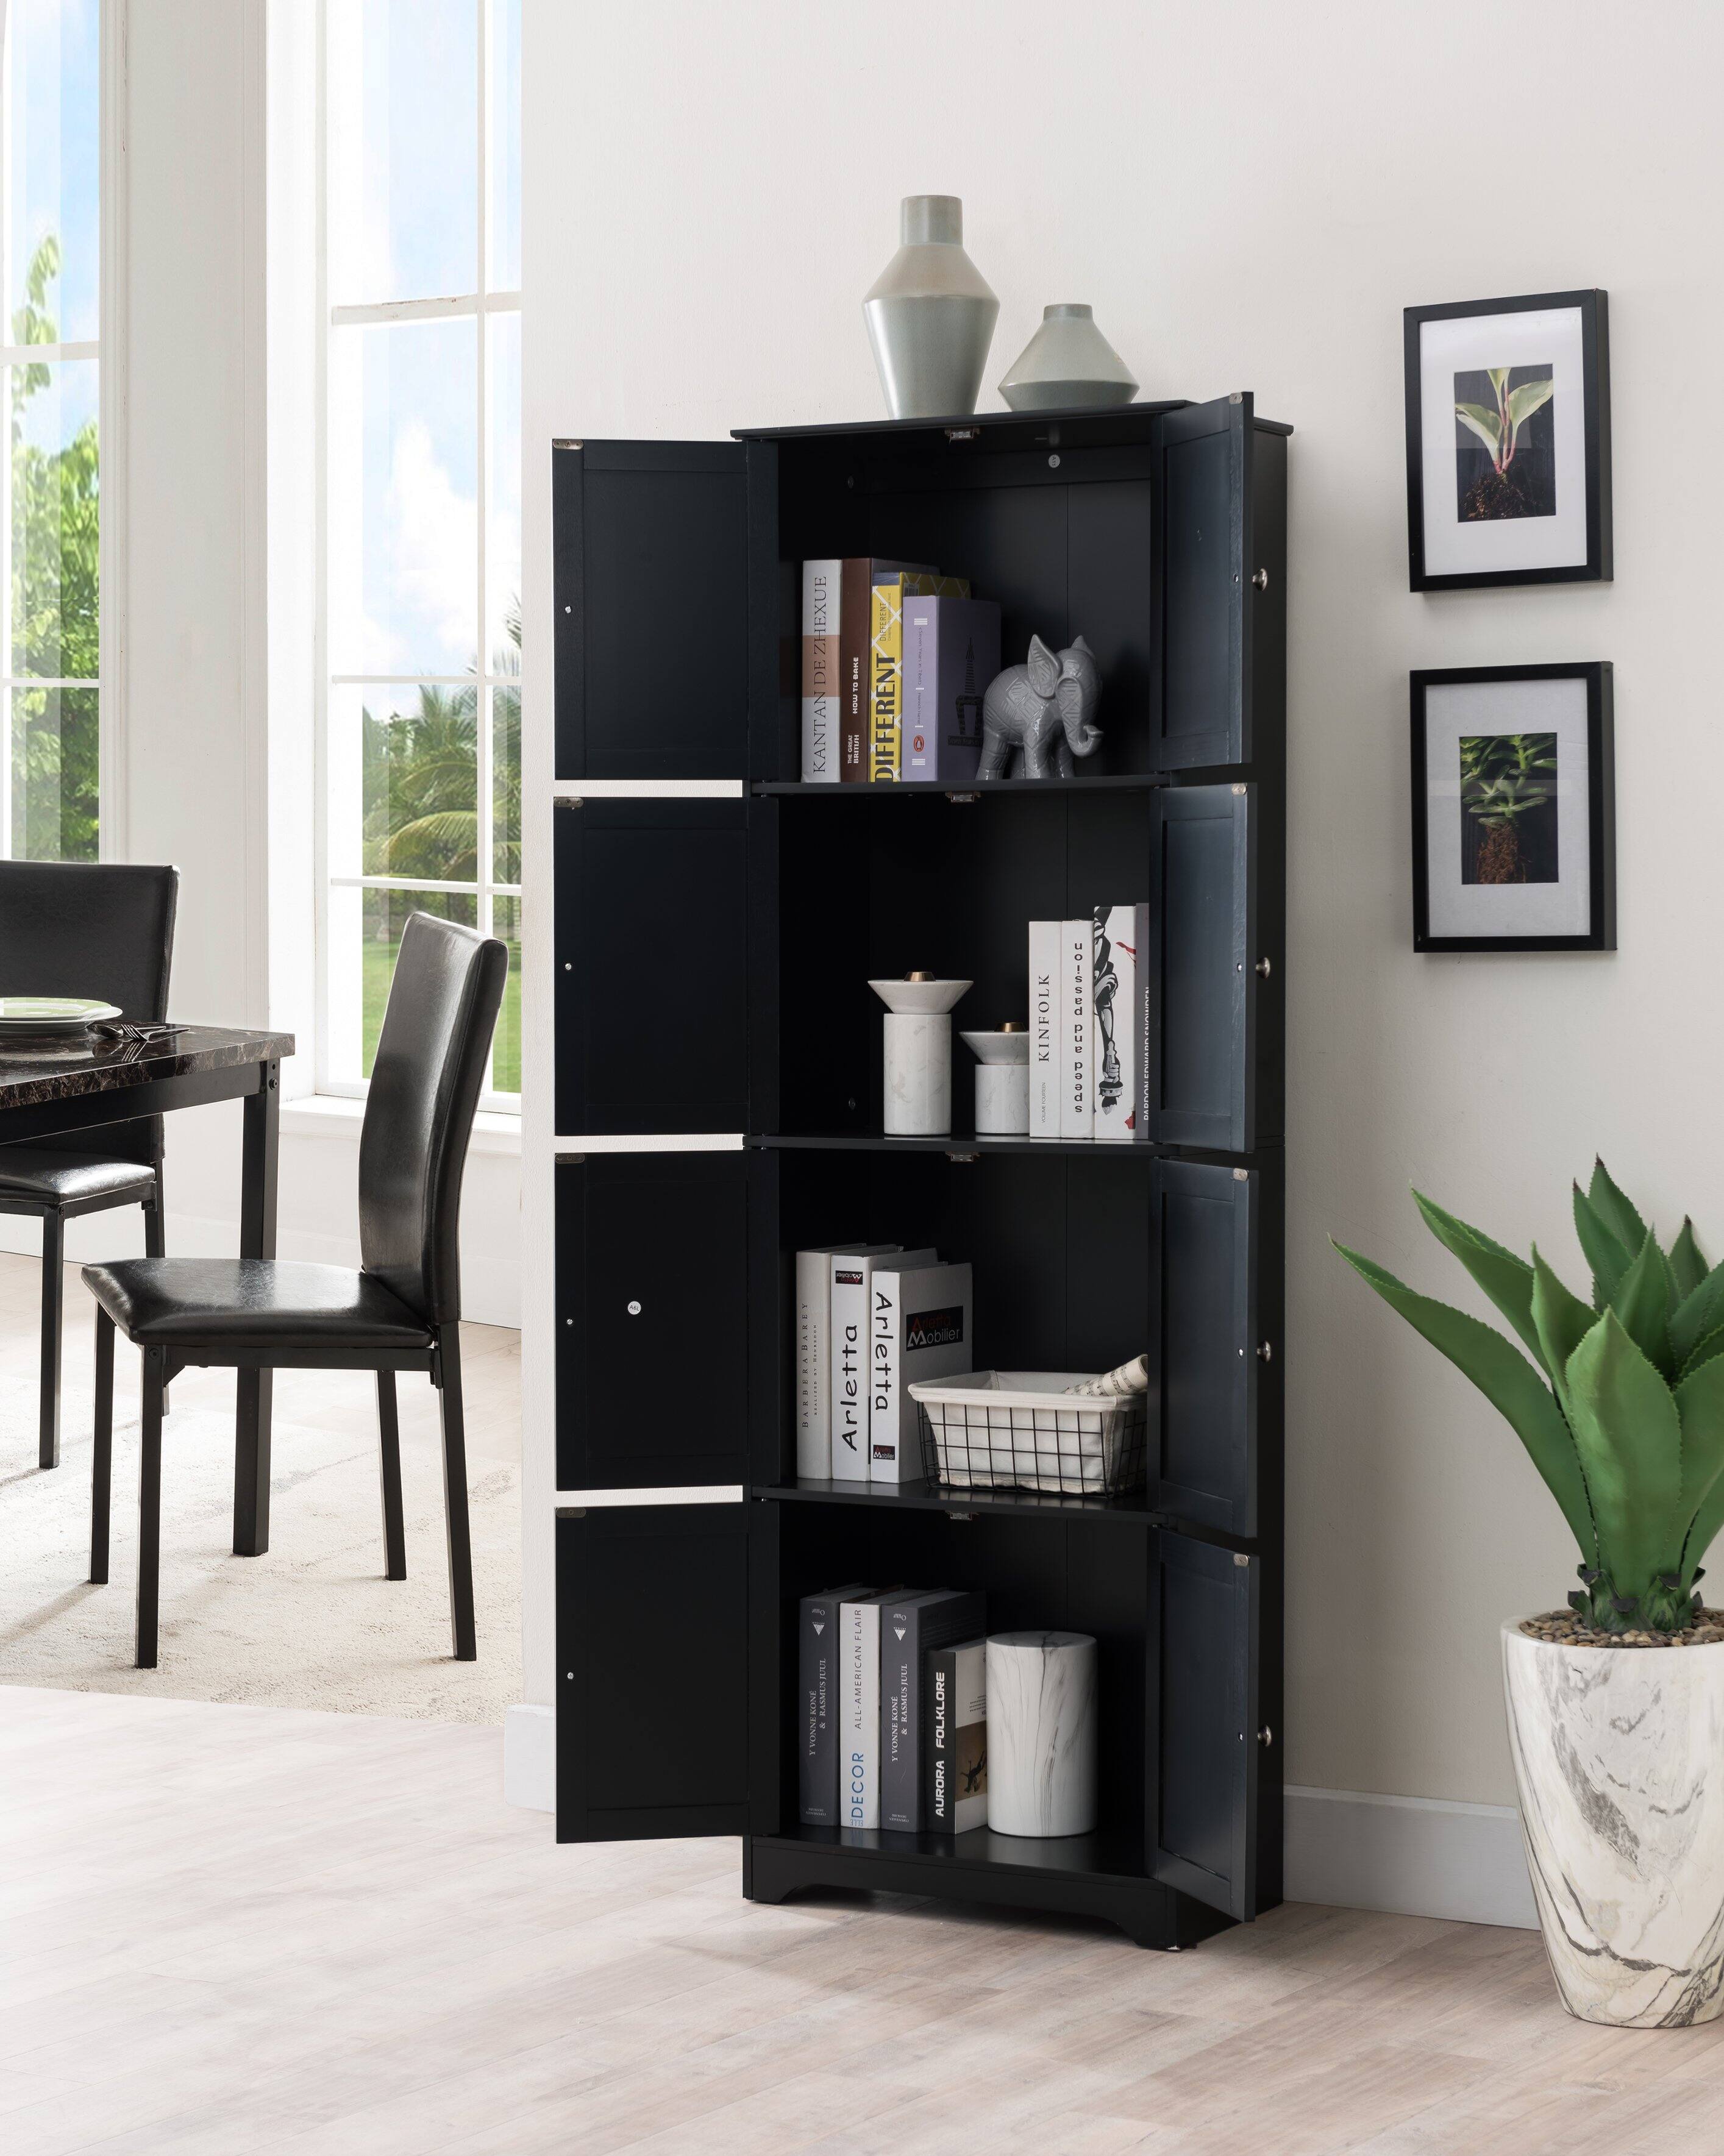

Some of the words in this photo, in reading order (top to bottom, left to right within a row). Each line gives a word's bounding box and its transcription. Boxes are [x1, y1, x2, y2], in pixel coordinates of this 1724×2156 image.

[814, 575, 827, 655] ZHEXUE
[814, 659, 826, 686] DE
[852, 682, 858, 692] TO
[814, 691, 827, 774] KANTAN
[874, 652, 895, 782] DIFFERENT
[1074, 943, 1083, 1016] passion
[1038, 975, 1050, 1062] KINFOLK
[1074, 1024, 1083, 1053] and
[1074, 1062, 1083, 1113] speed
[875, 1292, 894, 1411] Arletta
[907, 1327, 960, 1348] Mobilier
[912, 1314, 951, 1330] Arletta
[839, 1325, 858, 1452] Arletta
[936, 1672, 945, 1748] FOLKLORE
[851, 1753, 864, 1818] DECOR
[935, 1760, 944, 1817] AURORA
